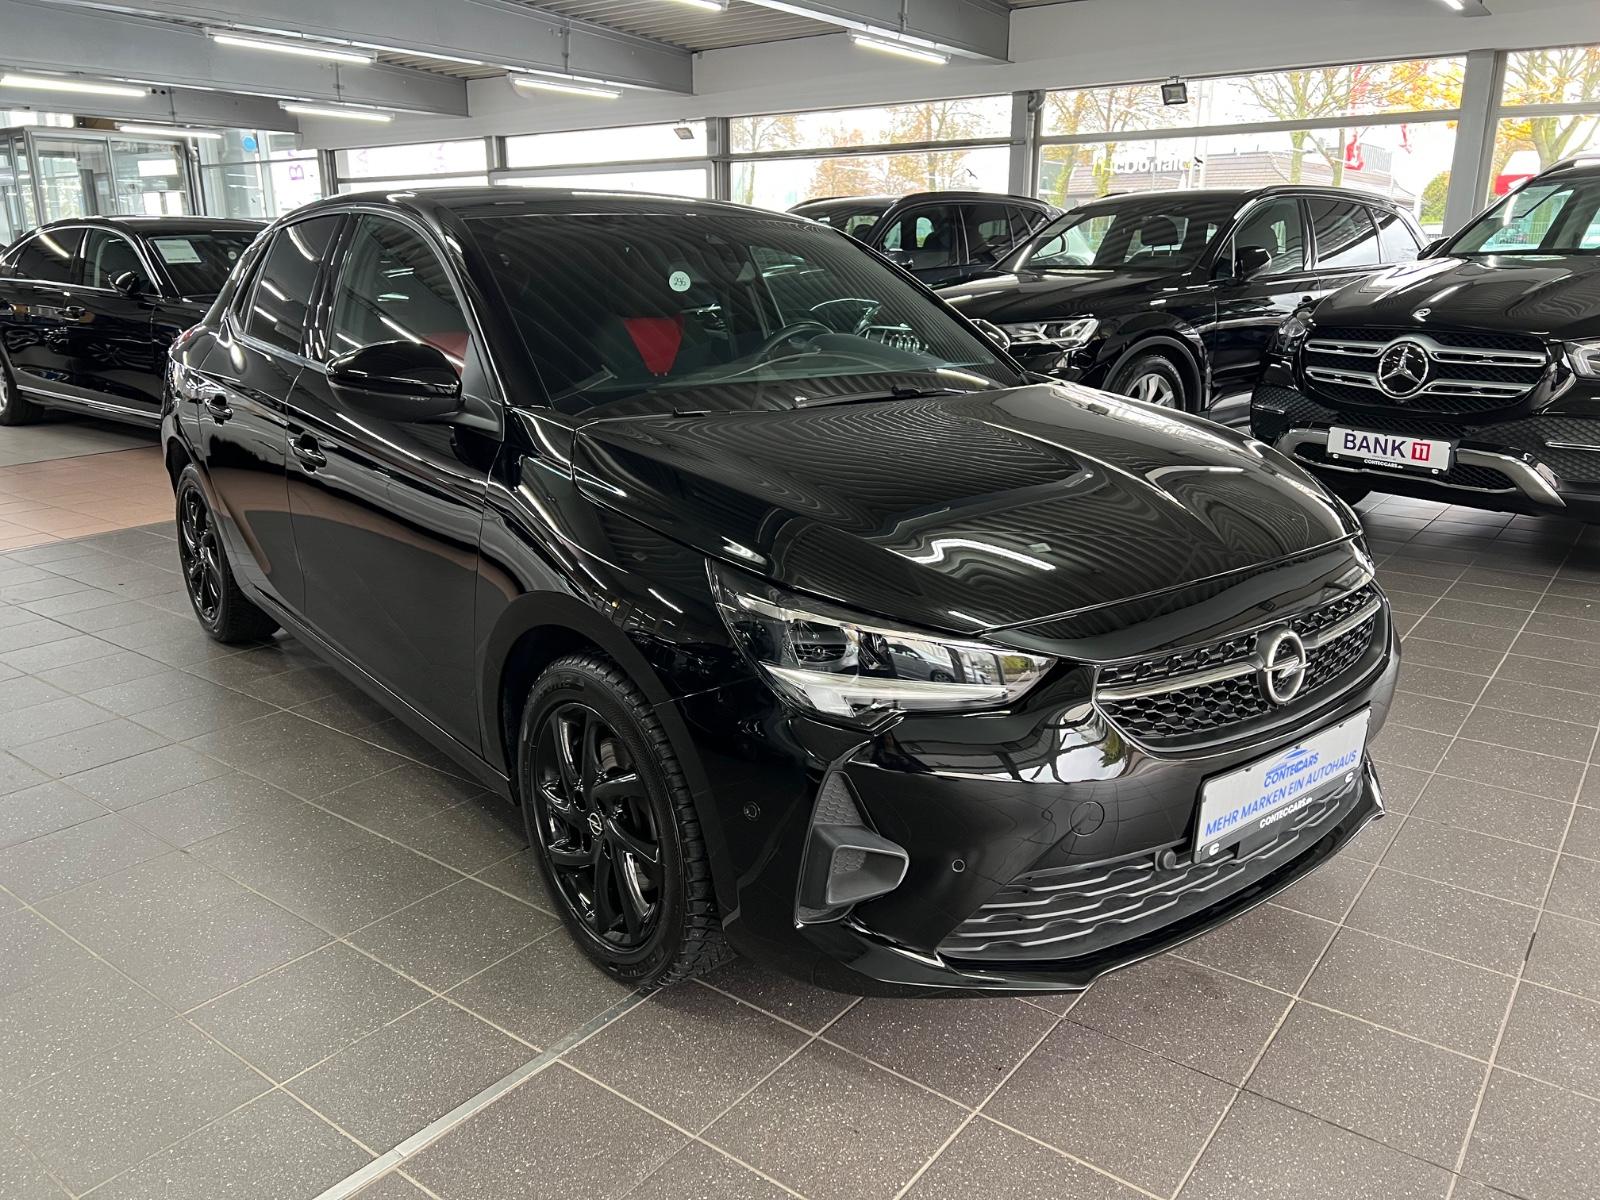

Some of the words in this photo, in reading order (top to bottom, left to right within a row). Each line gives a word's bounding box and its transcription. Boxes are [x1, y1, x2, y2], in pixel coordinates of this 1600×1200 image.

[1344, 432, 1408, 458] BANK
[1413, 443, 1429, 460] 11
[1205, 809, 1239, 837] MEHR
[1241, 786, 1288, 820] MARKEN
[1287, 778, 1304, 797] EIN
[1305, 750, 1358, 787] AUTOHAUS
